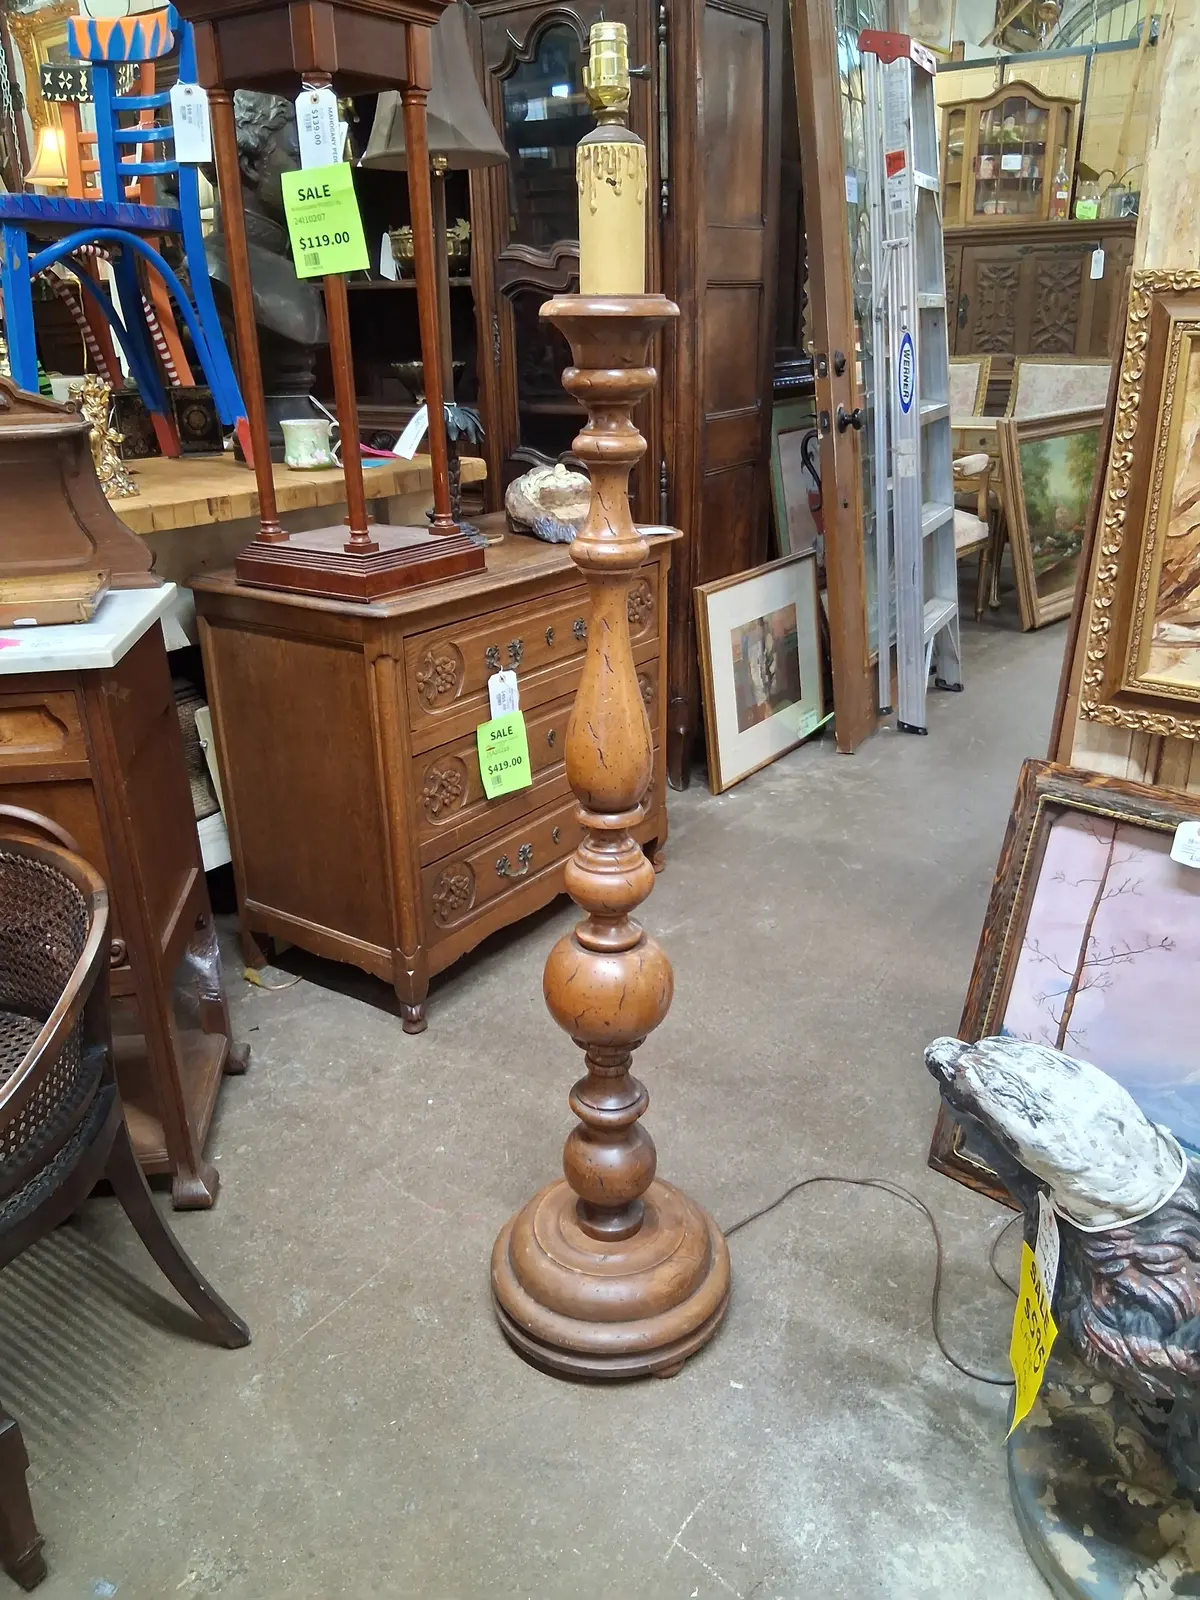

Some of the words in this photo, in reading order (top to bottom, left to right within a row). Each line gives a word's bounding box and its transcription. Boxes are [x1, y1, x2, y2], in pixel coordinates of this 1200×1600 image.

[311, 109, 322, 145] $139.00
[327, 107, 337, 146] MAHOGANY
[297, 184, 331, 202] SALE
[299, 231, 350, 251] $119.00
[903, 349, 912, 398] WERNER
[490, 725, 513, 741] SALE
[487, 756, 522, 775] $419.00
[1030, 1261, 1050, 1336] SALE
